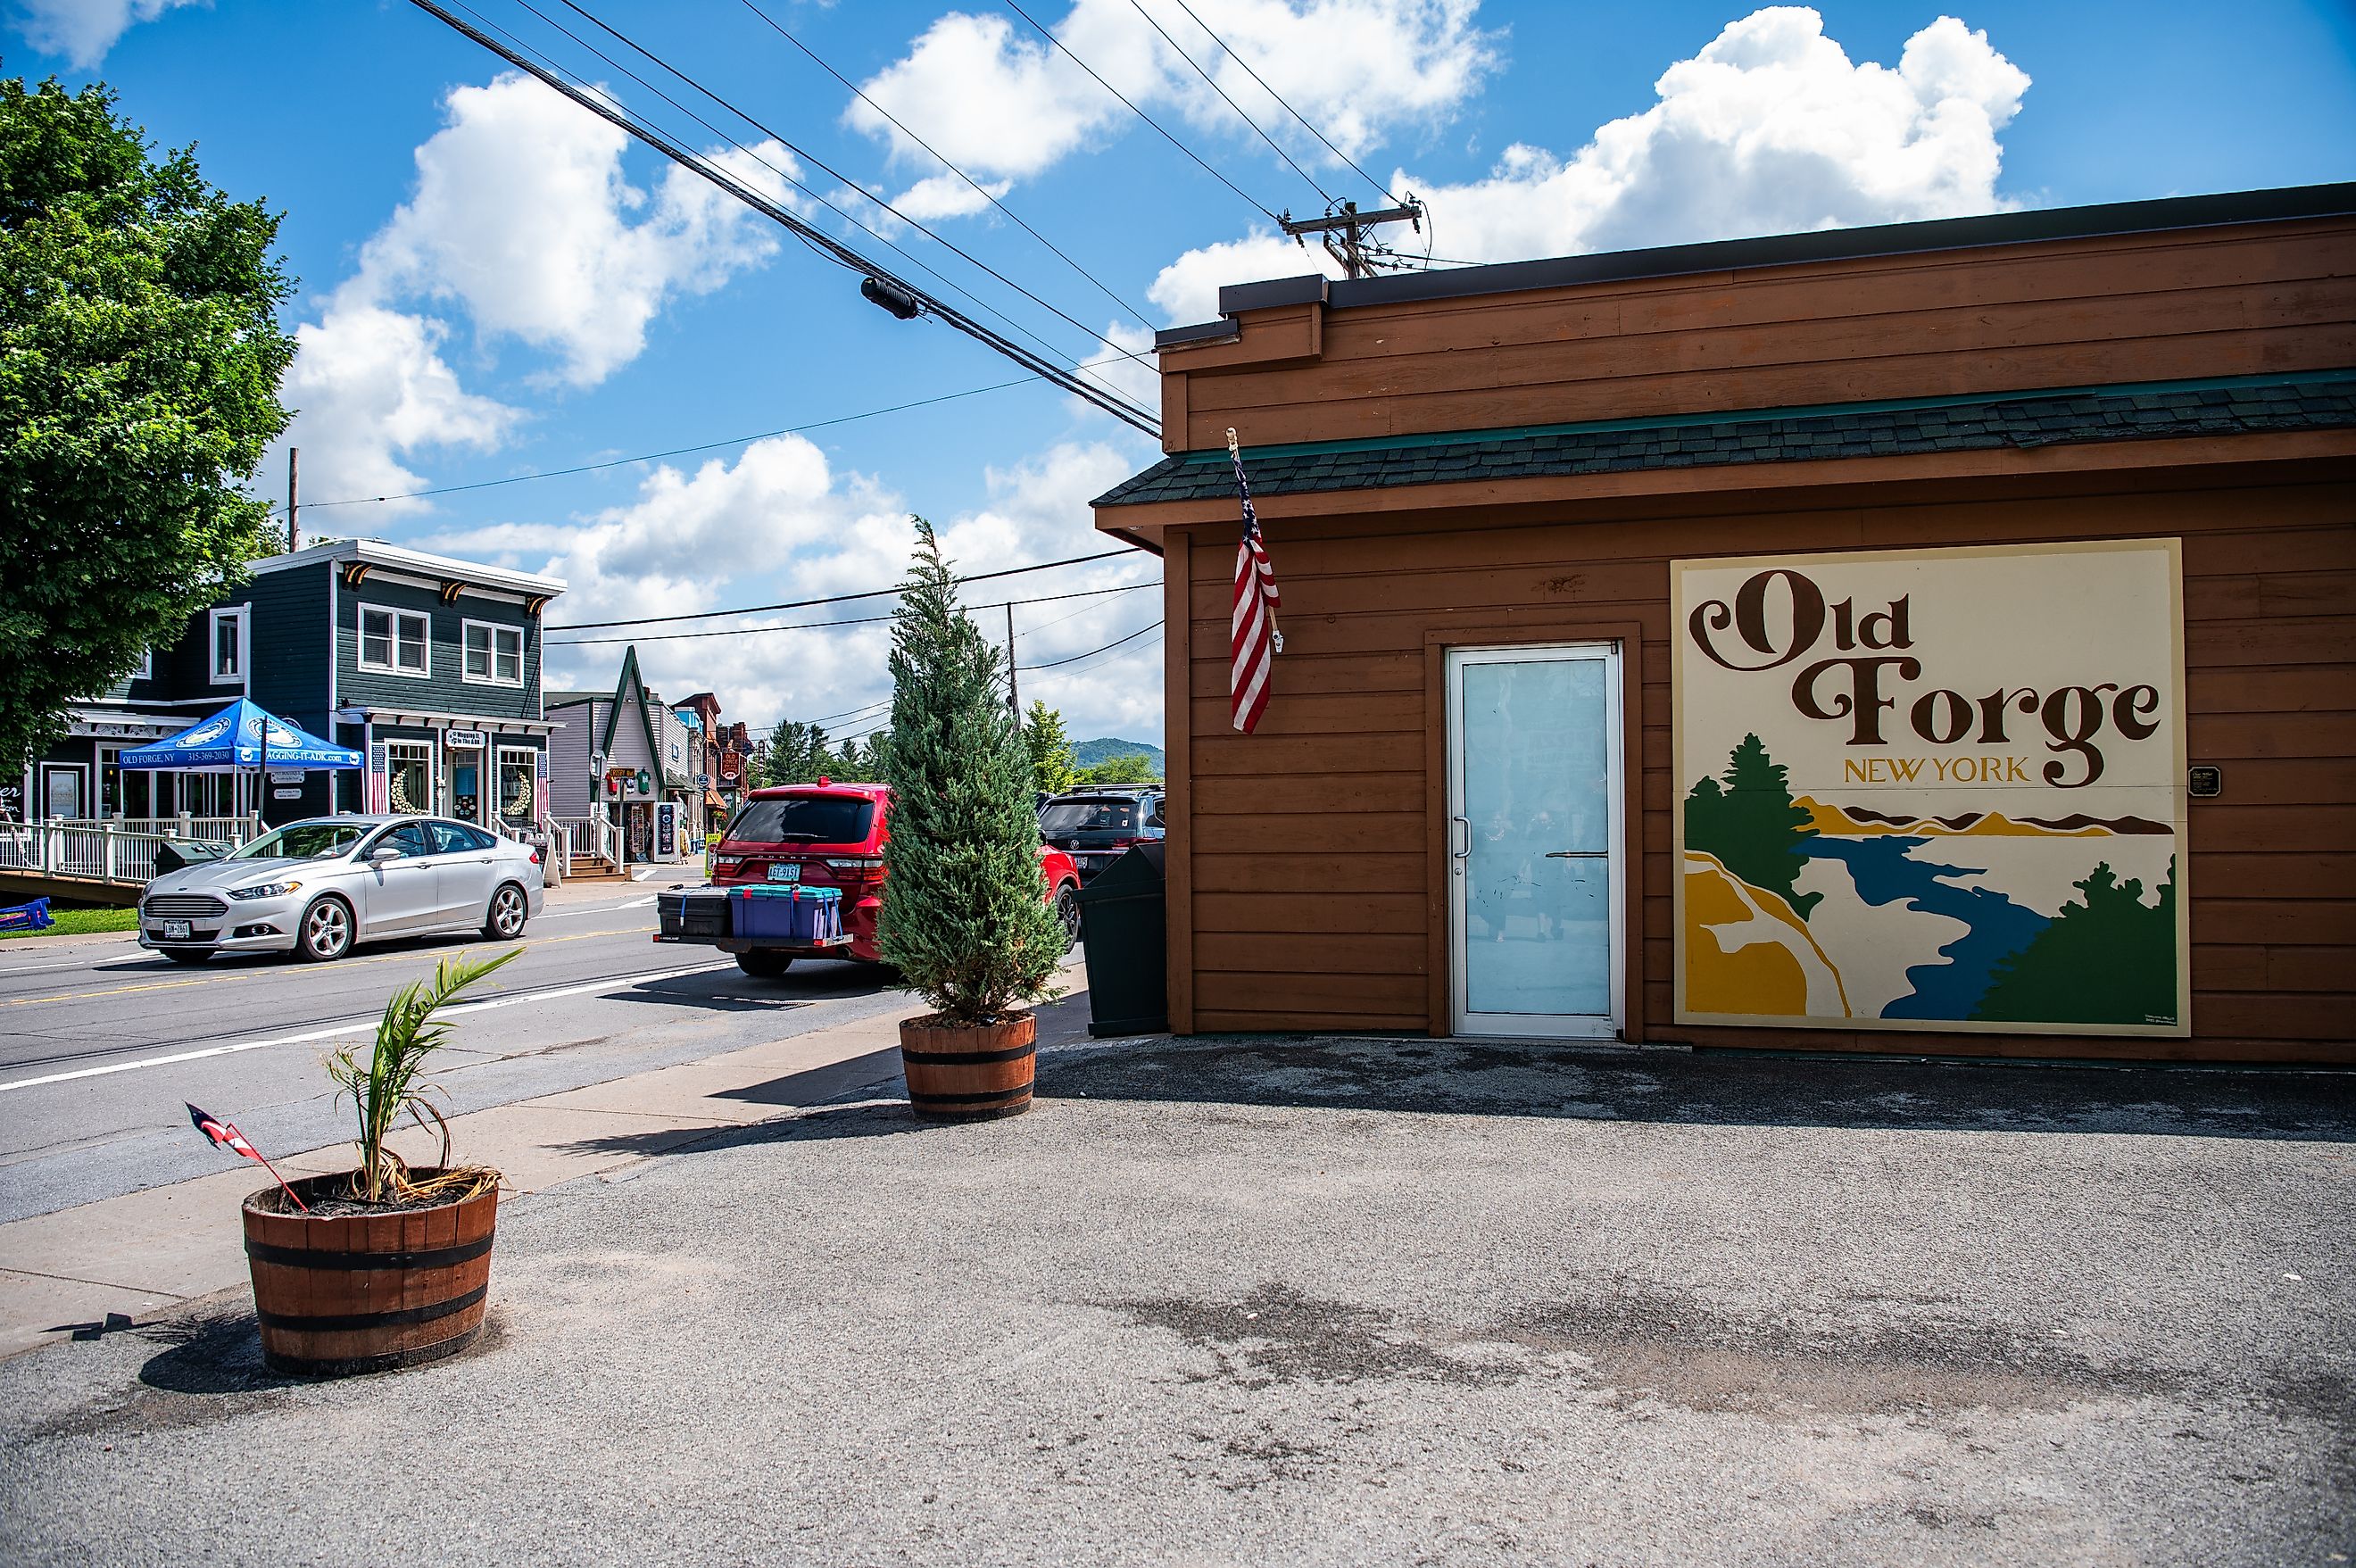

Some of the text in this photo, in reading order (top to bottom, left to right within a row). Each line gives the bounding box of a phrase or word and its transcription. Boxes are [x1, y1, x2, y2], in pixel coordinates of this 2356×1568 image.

[1688, 569, 1915, 672] Old
[1791, 656, 2161, 789] Forge
[122, 751, 229, 765] OLD FORGE, NY 315-369-2030
[265, 751, 342, 762] AGGING-IT-ADK.com
[1844, 756, 2032, 784] NEW YORK
